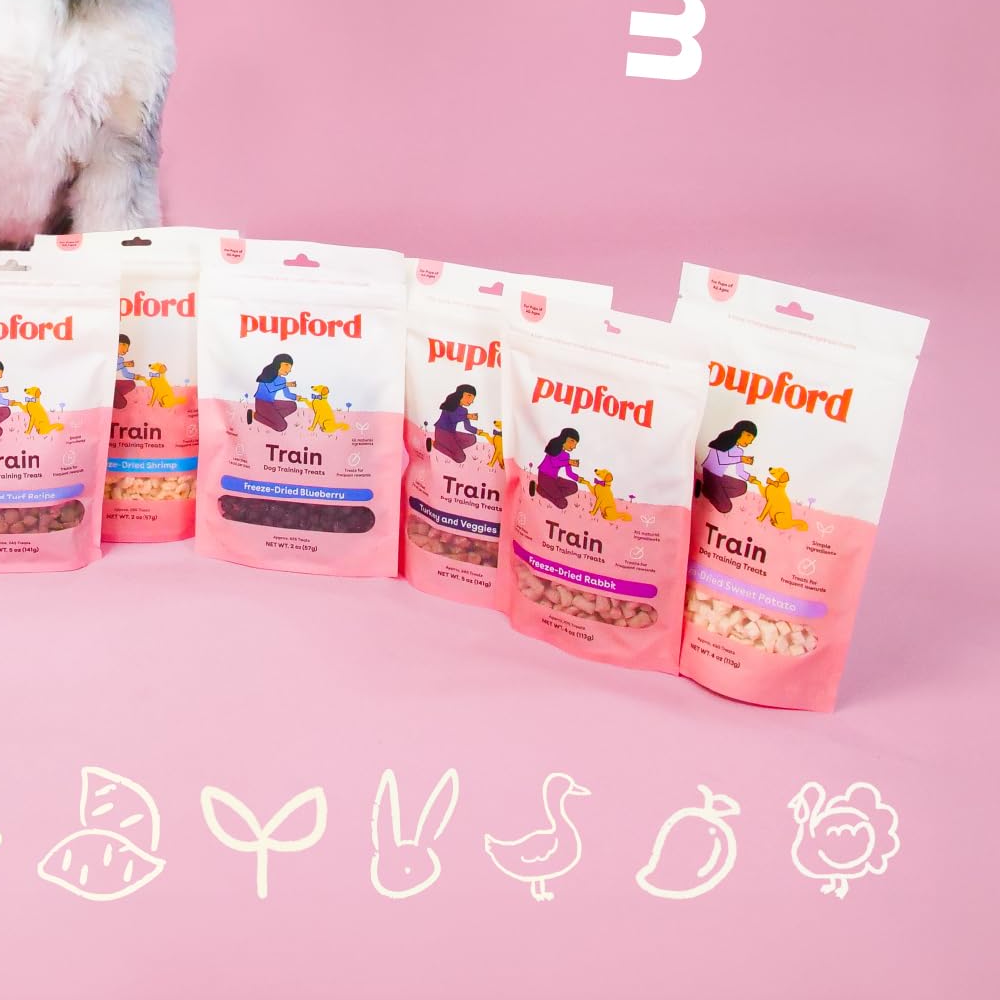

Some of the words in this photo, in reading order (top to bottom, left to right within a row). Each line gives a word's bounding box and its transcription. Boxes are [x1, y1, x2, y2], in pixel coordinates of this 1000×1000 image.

[240, 312, 362, 341] pupford
[531, 376, 654, 428] pupford
[110, 422, 162, 440] Train
[146, 461, 177, 469] Shrimp
[266, 444, 322, 465] Train
[264, 464, 276, 472] Dog
[278, 466, 303, 475] Training
[28, 492, 56, 500] Recipe
[244, 482, 298, 495] Freeze-Dried
[300, 488, 344, 499] Blueberry
[443, 475, 500, 502] Train
[454, 498, 479, 509] Training
[480, 502, 502, 512] Treats
[419, 504, 440, 522] Turkey
[441, 516, 458, 526] and
[460, 520, 497, 534] Veggies
[302, 544, 318, 552] (57g)
[546, 520, 603, 554] Train
[705, 522, 767, 564] Train
[542, 541, 554, 552] Dog
[556, 546, 581, 559] Training
[583, 553, 605, 564] Treats
[699, 546, 711, 558] Dog
[713, 553, 741, 569] Training
[743, 563, 767, 576] Treats
[474, 579, 491, 588] (141g)
[528, 556, 582, 582] Freeze-Dried
[584, 575, 616, 590] Rabbit
[726, 579, 757, 599] Sweet
[758, 593, 797, 612] Potato
[542, 618, 552, 626] NET
[690, 643, 701, 652] NET
[724, 657, 741, 668] (113g)
